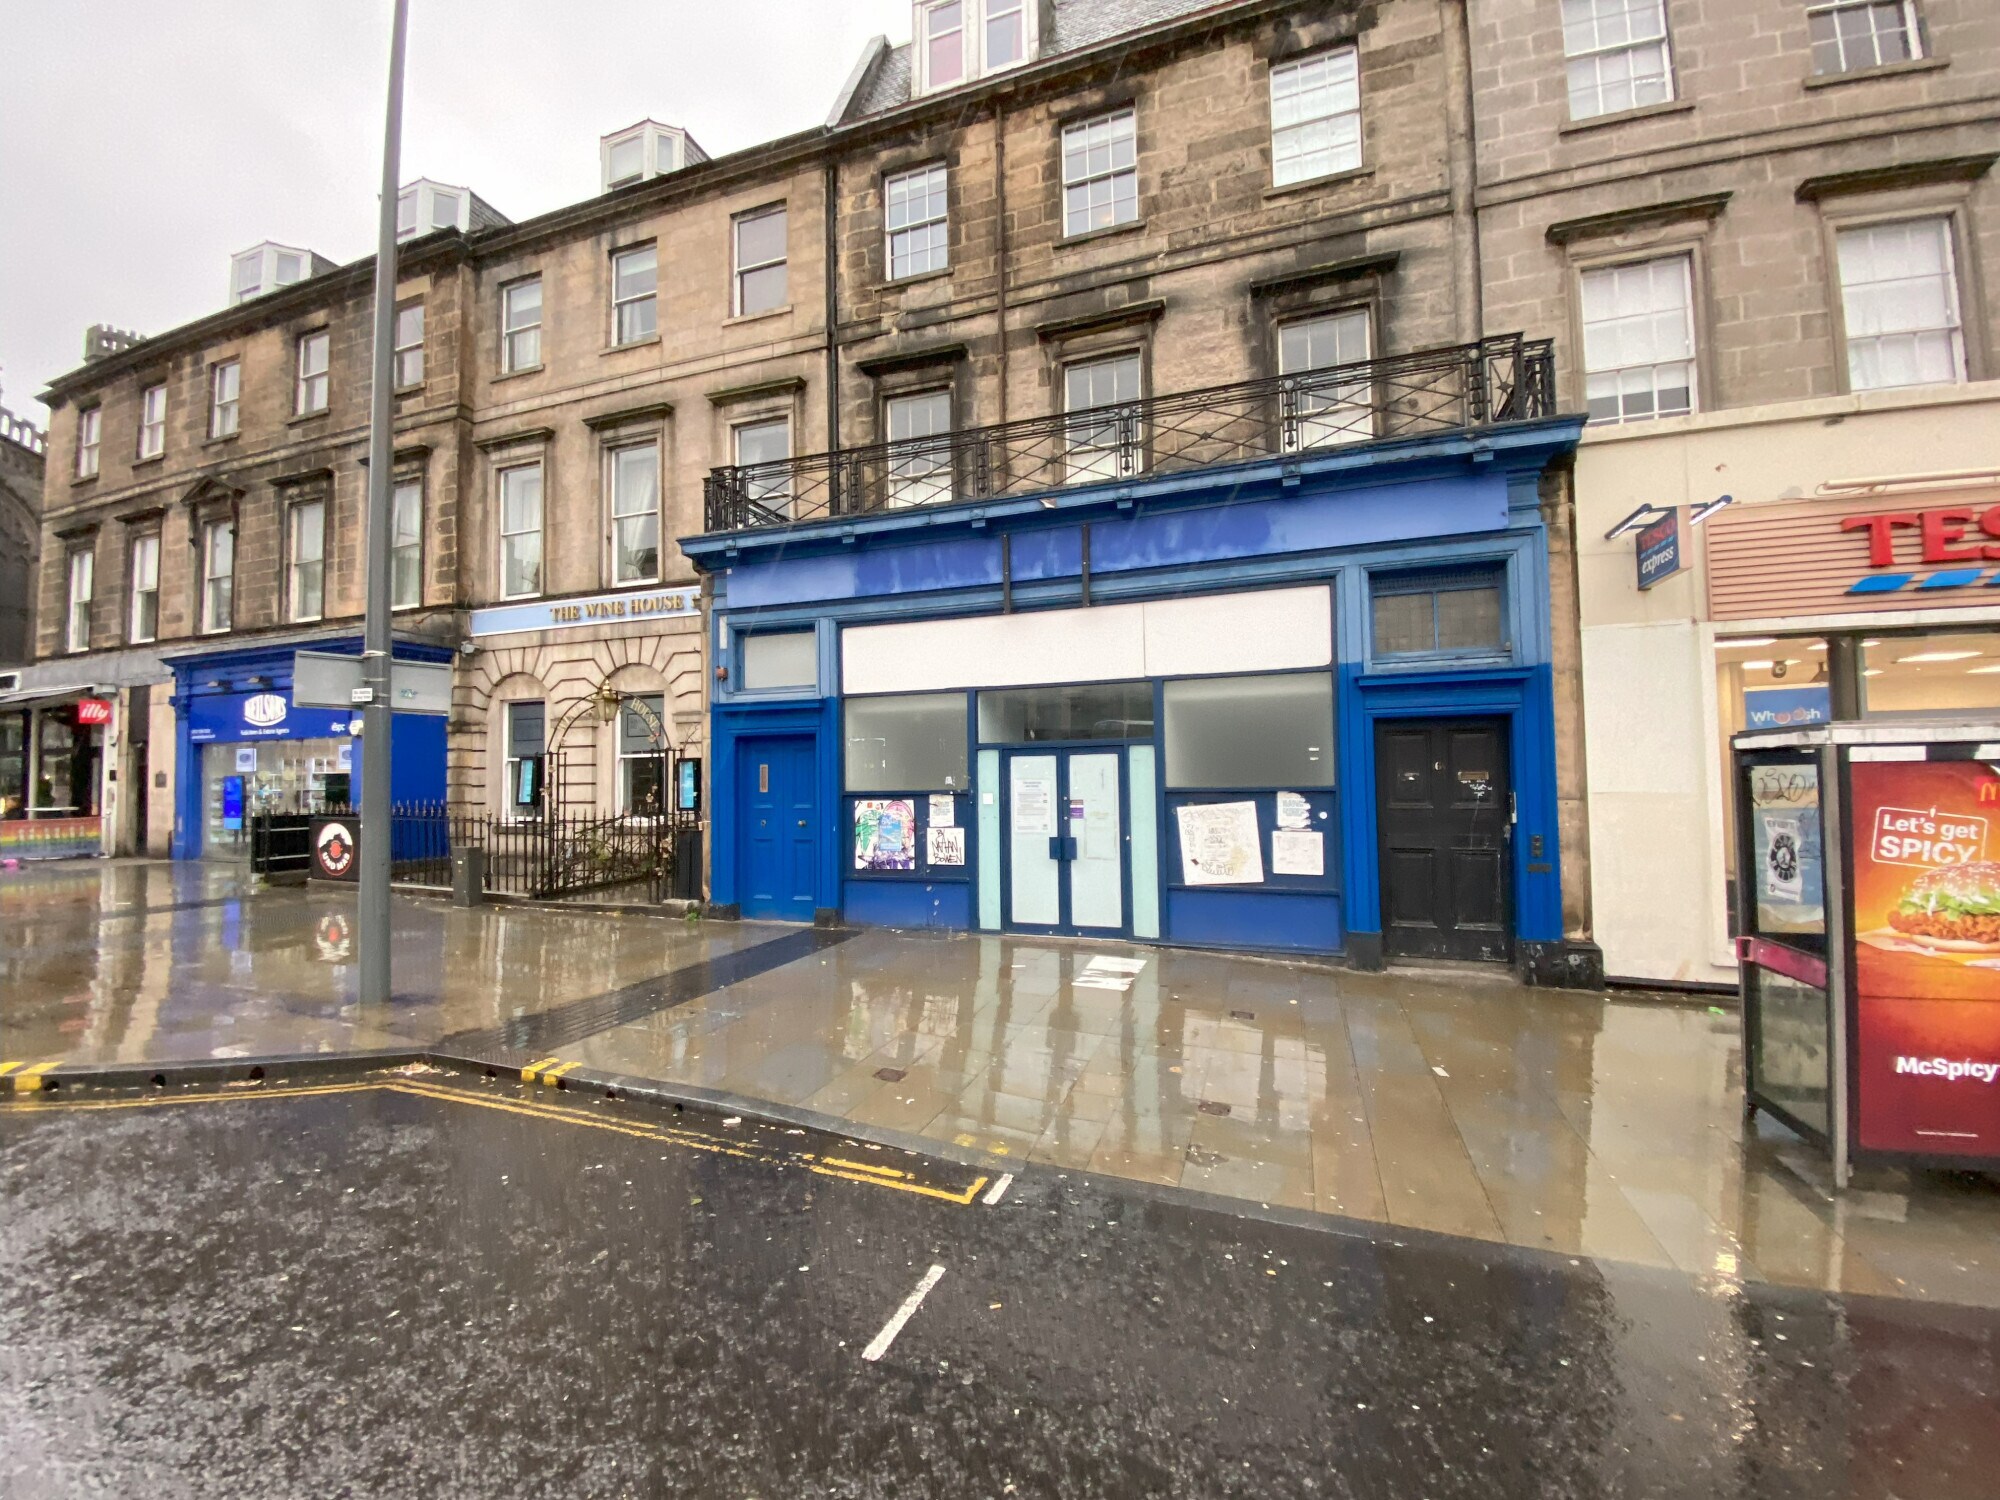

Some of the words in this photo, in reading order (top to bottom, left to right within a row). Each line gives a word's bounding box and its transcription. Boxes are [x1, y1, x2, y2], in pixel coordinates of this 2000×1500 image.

[1642, 546, 1674, 574] express
[550, 605, 580, 623] THE
[585, 600, 625, 618] WINE
[630, 594, 685, 613] HOUSE
[81, 703, 109, 722] illy
[1883, 813, 1936, 835] Let's
[1940, 823, 1979, 841] get
[1879, 835, 1978, 864] SPICY
[1896, 1056, 1998, 1082] McSpicy
